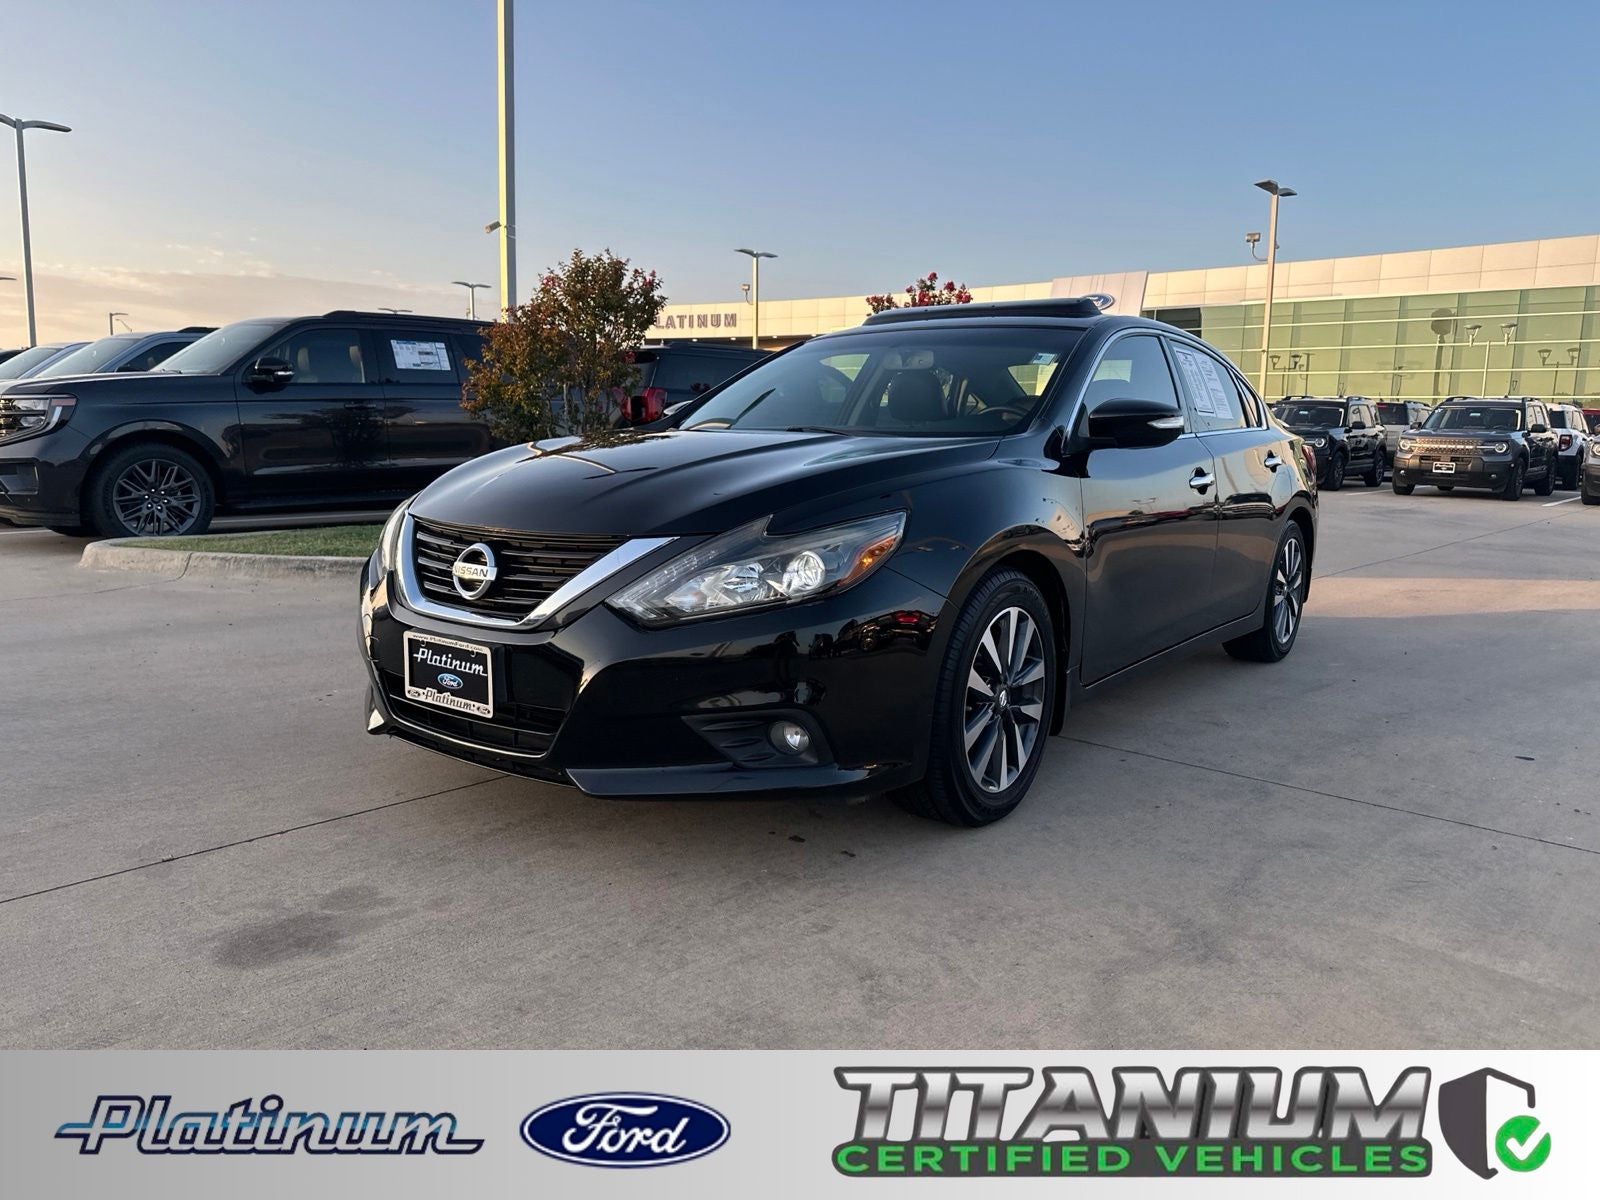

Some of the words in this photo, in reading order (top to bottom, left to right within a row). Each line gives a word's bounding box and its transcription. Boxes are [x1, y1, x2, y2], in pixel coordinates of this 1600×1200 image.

[655, 313, 737, 329] LATINUM
[413, 647, 488, 677] Platinum
[442, 674, 459, 687] Ford
[425, 690, 474, 711] Platinum
